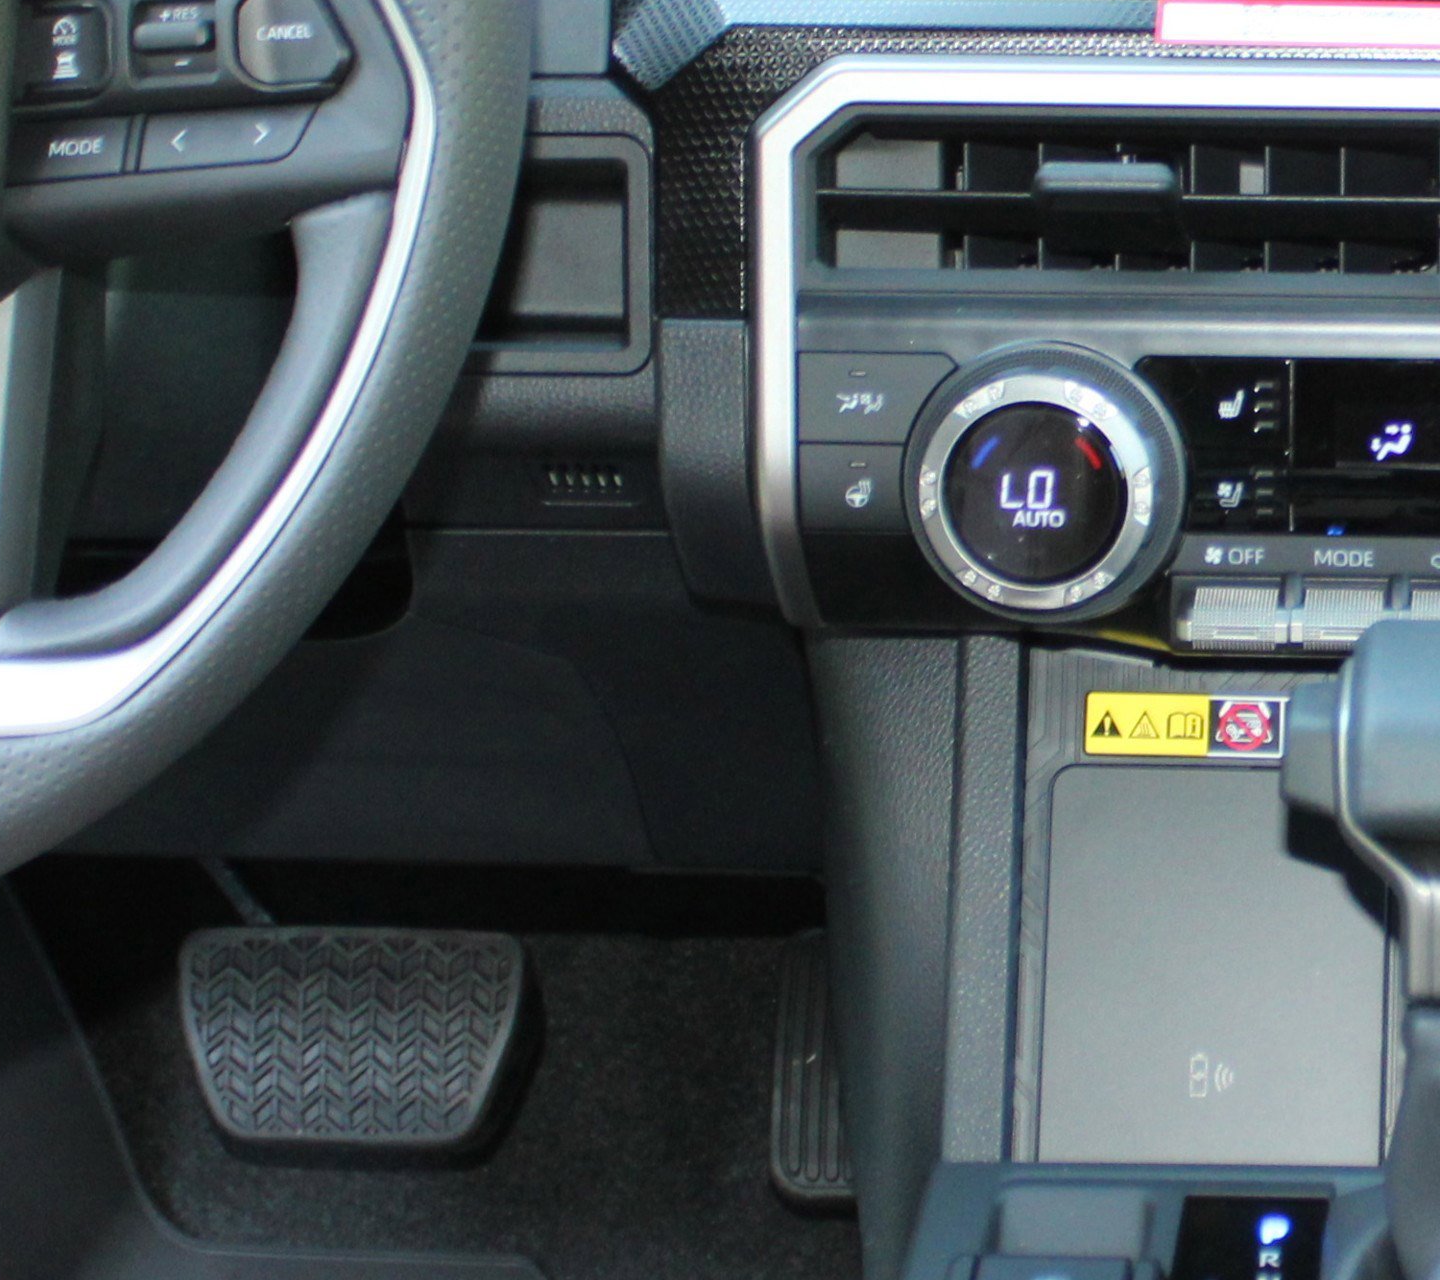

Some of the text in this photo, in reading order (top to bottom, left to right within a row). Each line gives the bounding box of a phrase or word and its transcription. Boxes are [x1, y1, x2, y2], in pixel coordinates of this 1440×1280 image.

[255, 23, 313, 42] CANCEL
[48, 136, 106, 158] MODE
[1000, 469, 1056, 510] LO
[1012, 509, 1066, 528] AUTO
[1228, 548, 1265, 565] OFF
[1313, 549, 1375, 568] MODE
[1259, 1250, 1281, 1268] R
